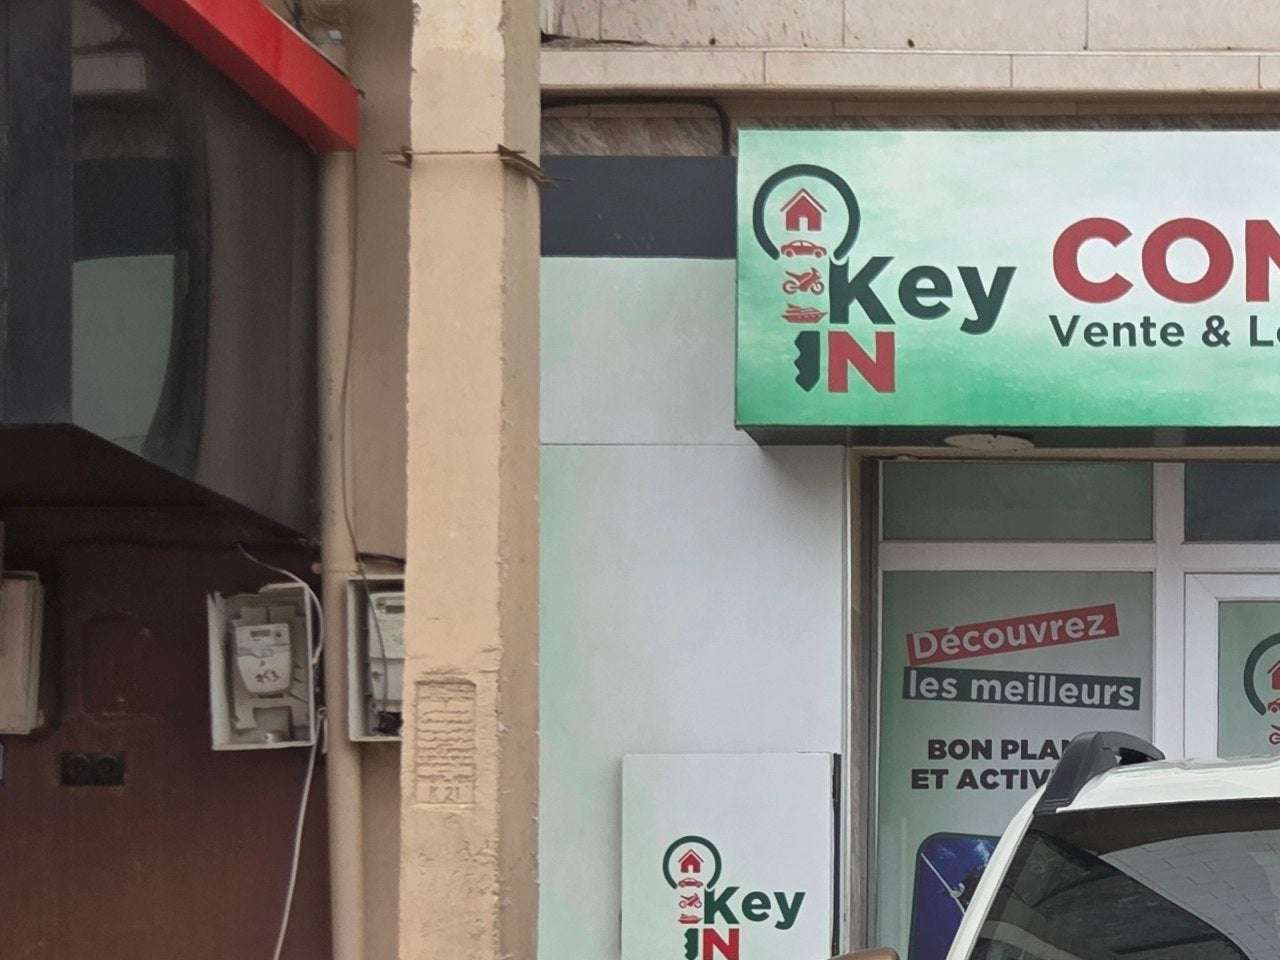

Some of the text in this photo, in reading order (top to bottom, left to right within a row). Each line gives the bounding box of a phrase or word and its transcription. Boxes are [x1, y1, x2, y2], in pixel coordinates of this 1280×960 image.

[828, 255, 1017, 335] Key
[1049, 315, 1185, 348] Vente
[1202, 315, 1231, 348] &
[913, 611, 1107, 660] Découvrez
[909, 669, 1135, 706] les meilleurs
[928, 739, 992, 760] BON
[911, 769, 1054, 789] ET ACTIV
[703, 886, 806, 930] Key
